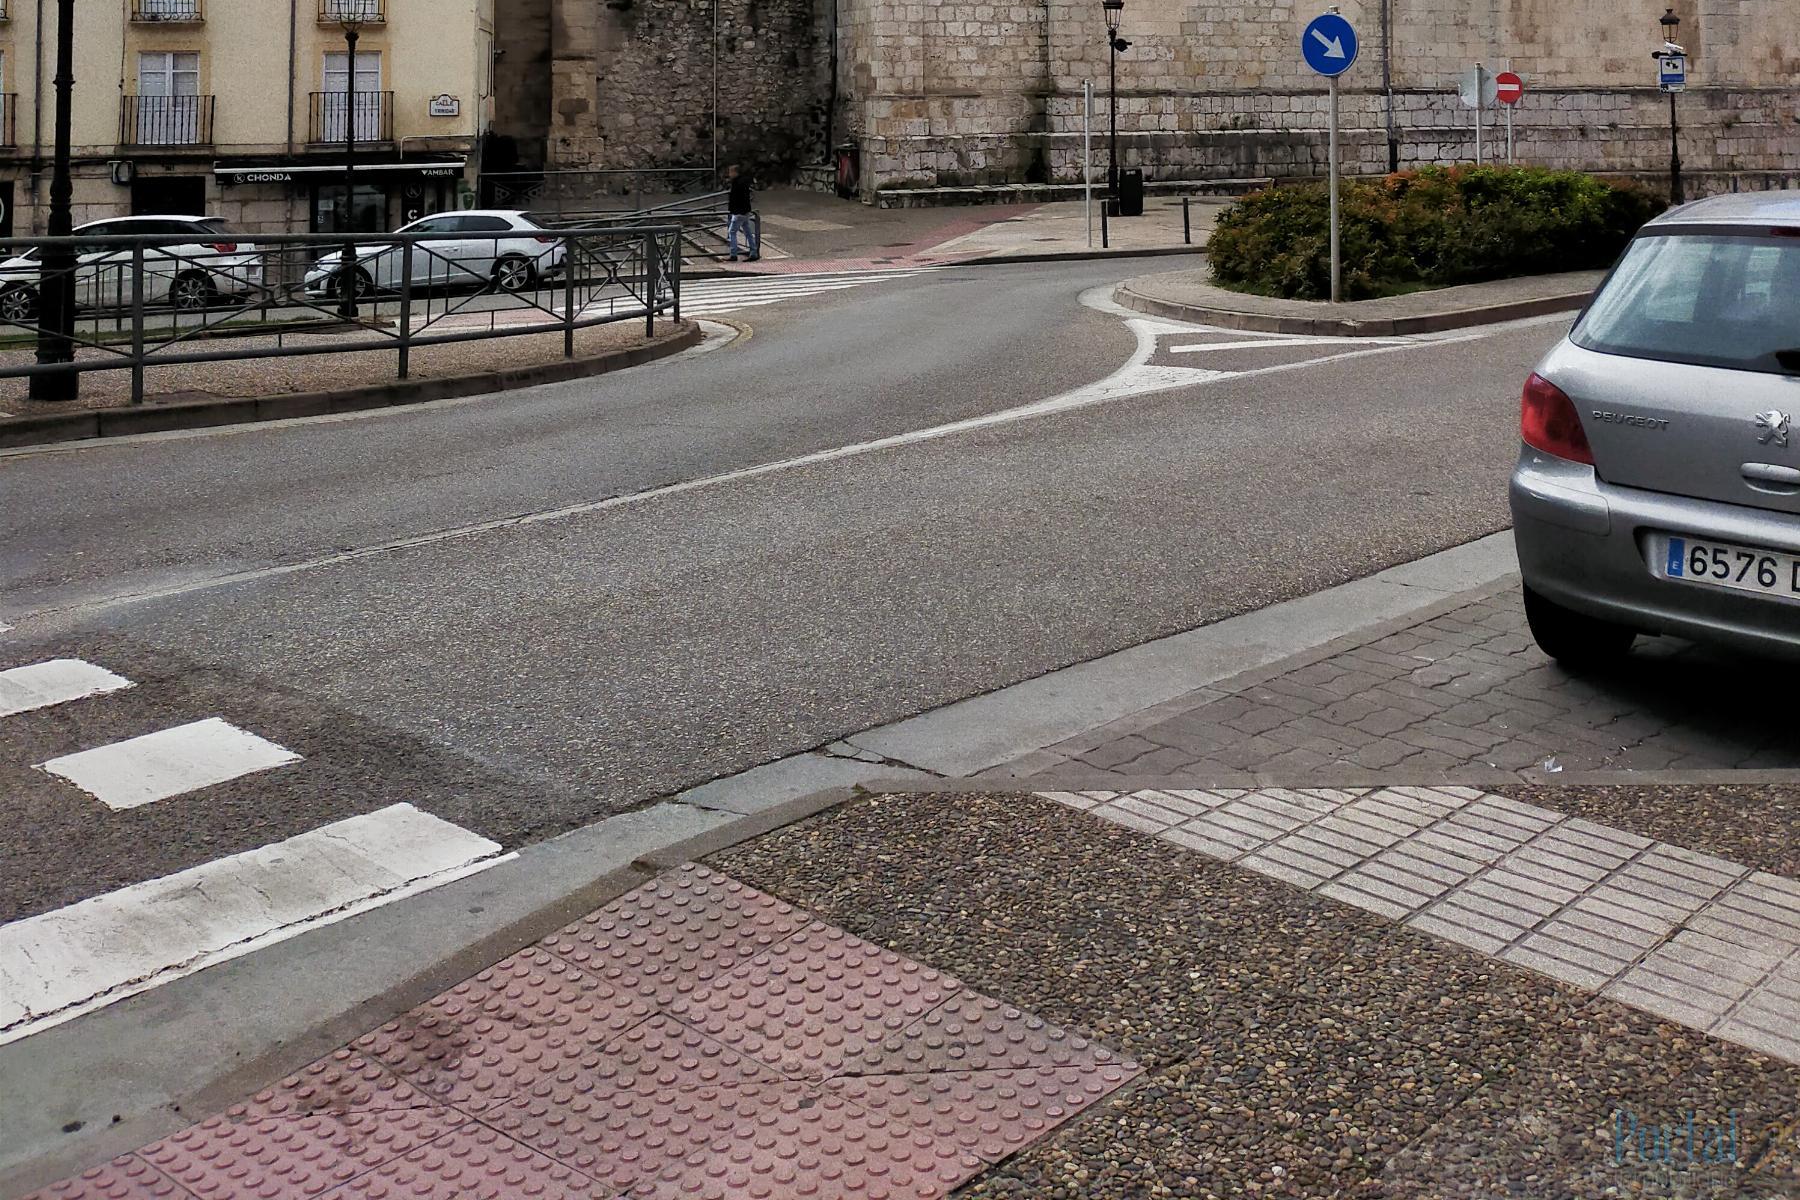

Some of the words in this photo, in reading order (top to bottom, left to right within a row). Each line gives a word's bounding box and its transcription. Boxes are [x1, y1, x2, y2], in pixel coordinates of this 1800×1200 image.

[247, 173, 292, 182] CHONDA
[1592, 410, 1670, 431] PEUGEOT
[1671, 561, 1679, 570] E
[1689, 545, 1778, 588] 6576
